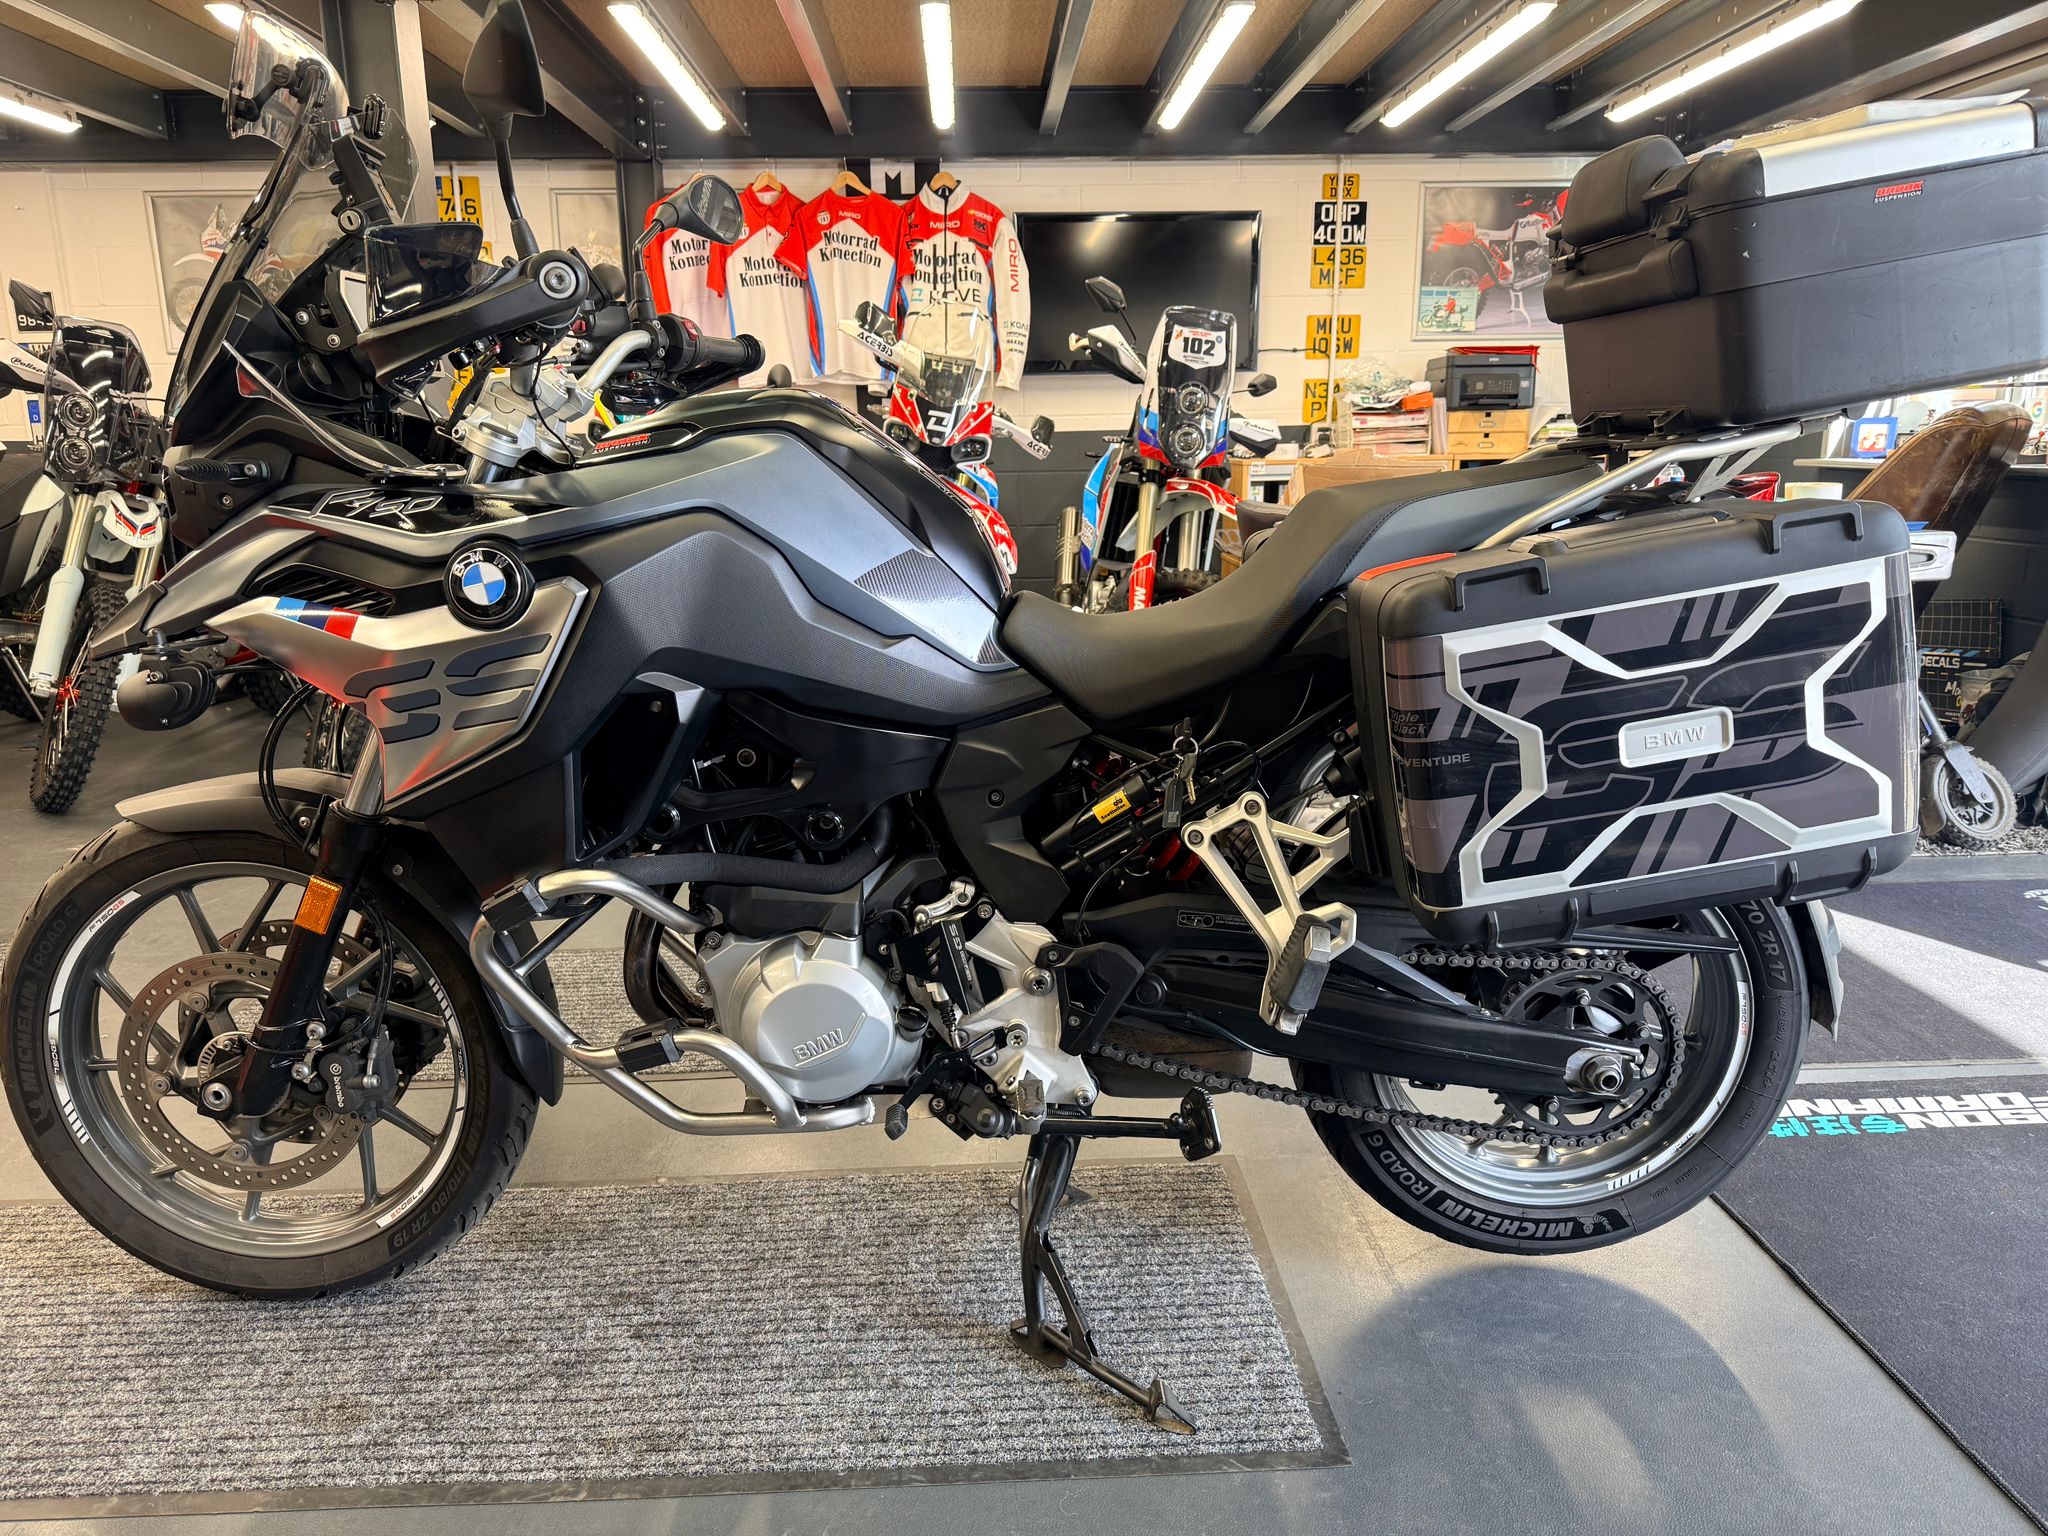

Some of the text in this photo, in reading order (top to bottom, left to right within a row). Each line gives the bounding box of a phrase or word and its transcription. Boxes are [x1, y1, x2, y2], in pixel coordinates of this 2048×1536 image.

[1329, 176, 1355, 187] Y15
[1330, 187, 1353, 198] DX
[1874, 190, 1922, 203] SUSPENSION
[930, 220, 961, 230] MIRO
[1314, 225, 1367, 244] 400W
[671, 238, 709, 255] Motor
[1313, 247, 1365, 266] L436
[1008, 238, 1019, 293] MIRO
[1183, 336, 1216, 357] 102
[453, 550, 509, 577] BMW
[1920, 655, 1961, 669] DECALS
[1390, 710, 1420, 722] Triple
[1393, 722, 1427, 735] Black
[1644, 725, 1706, 750] BMW
[88, 898, 125, 933] F750GS
[1756, 930, 1780, 956] ZR
[1768, 961, 1787, 983] 17
[15, 904, 78, 1094] MICHELIN ROAD 6
[792, 1027, 844, 1061] BMW
[333, 1076, 345, 1108] brembo
[1900, 1107, 2048, 1128] SON
[1366, 1132, 1574, 1239] MICHELIN ROAD 6
[390, 1187, 425, 1220] F750GS
[411, 1213, 430, 1234] ZR
[393, 1230, 410, 1248] 19
